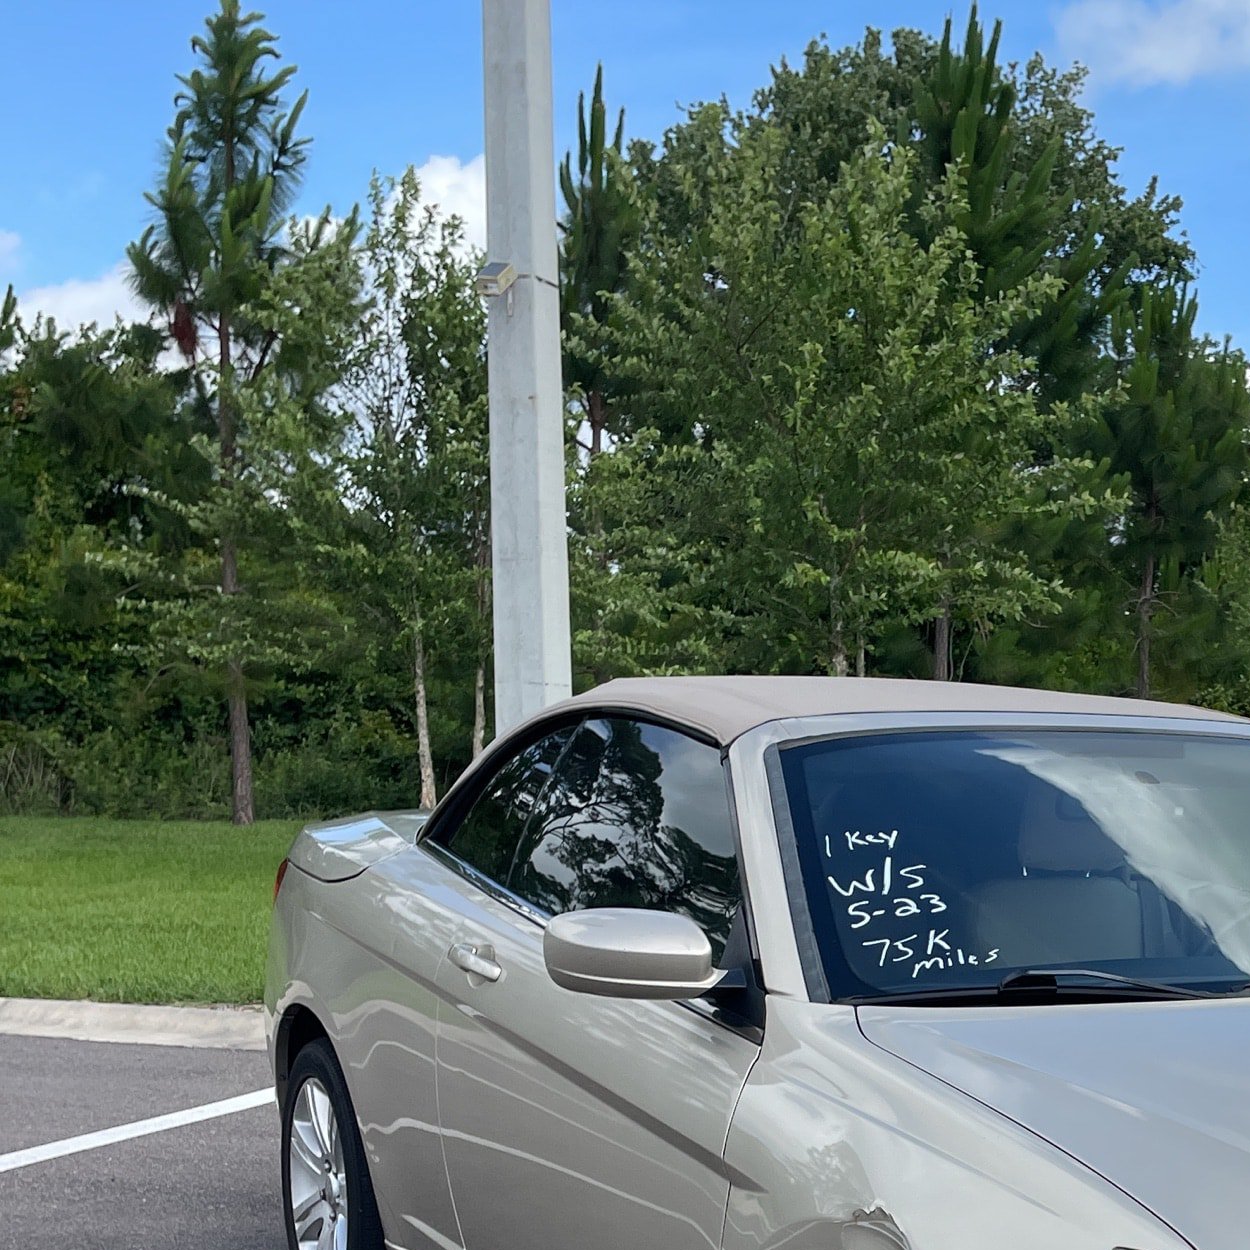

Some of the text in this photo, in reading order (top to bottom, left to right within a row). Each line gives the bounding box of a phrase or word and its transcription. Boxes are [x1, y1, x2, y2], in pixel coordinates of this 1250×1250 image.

[825, 834, 832, 858] 1
[827, 856, 927, 896] W/S
[847, 894, 948, 929] 5-23
[911, 948, 1001, 979] miles
